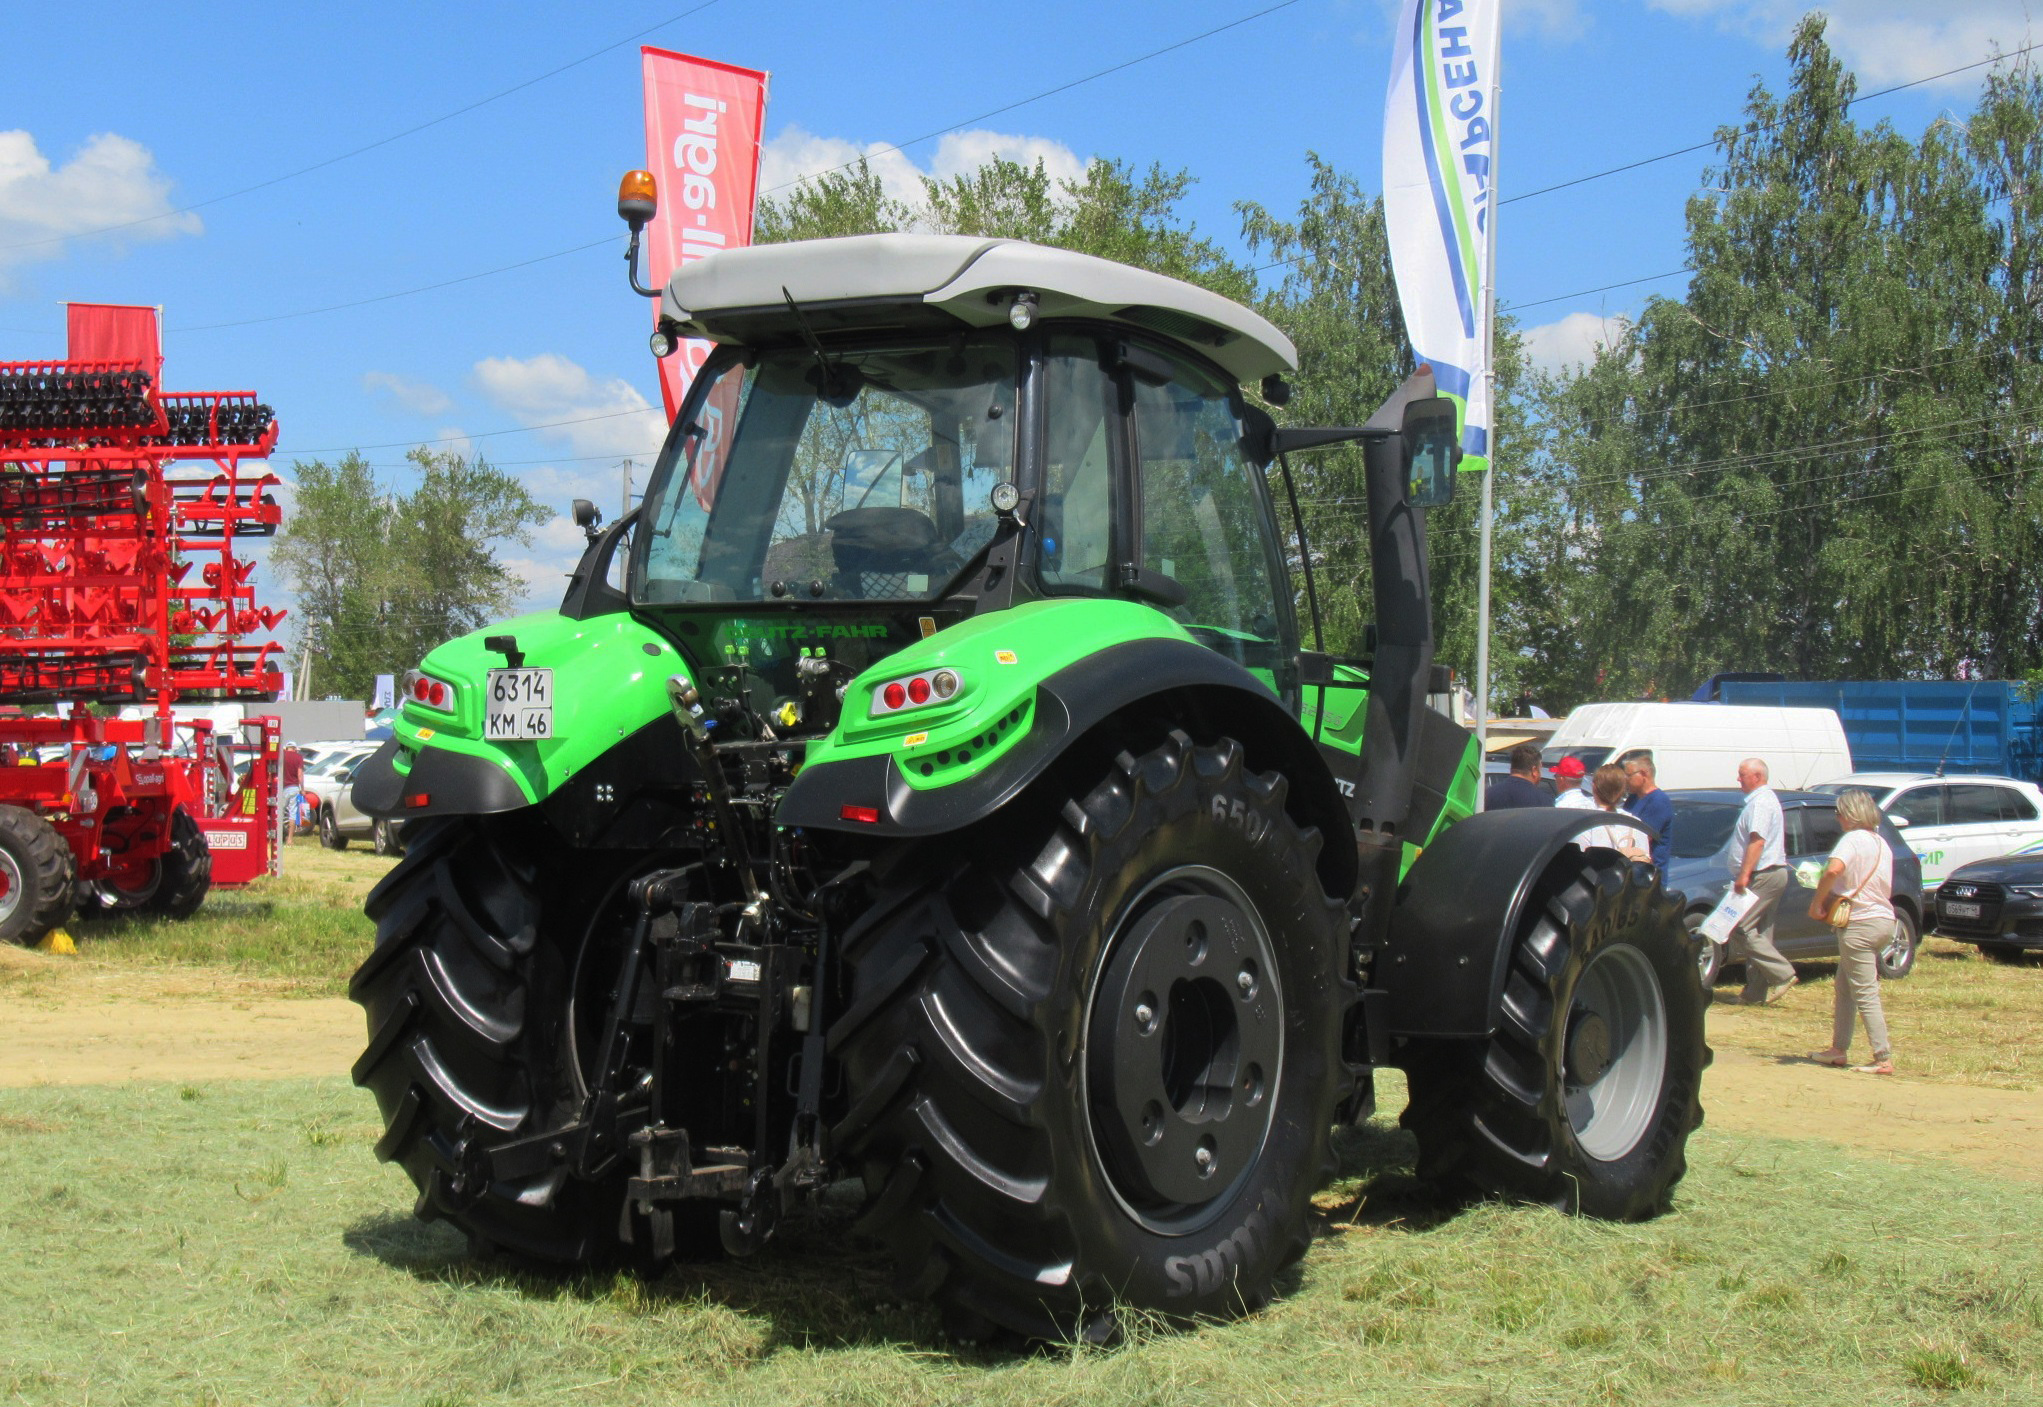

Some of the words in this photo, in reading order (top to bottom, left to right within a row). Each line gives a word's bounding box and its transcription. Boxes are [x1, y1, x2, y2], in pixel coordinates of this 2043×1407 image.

[723, 625, 888, 639] DEUTZ-FAHR
[494, 674, 545, 702] 6314
[490, 713, 515, 735] КМ
[527, 713, 547, 735] 46
[208, 836, 242, 845] LUPUS
